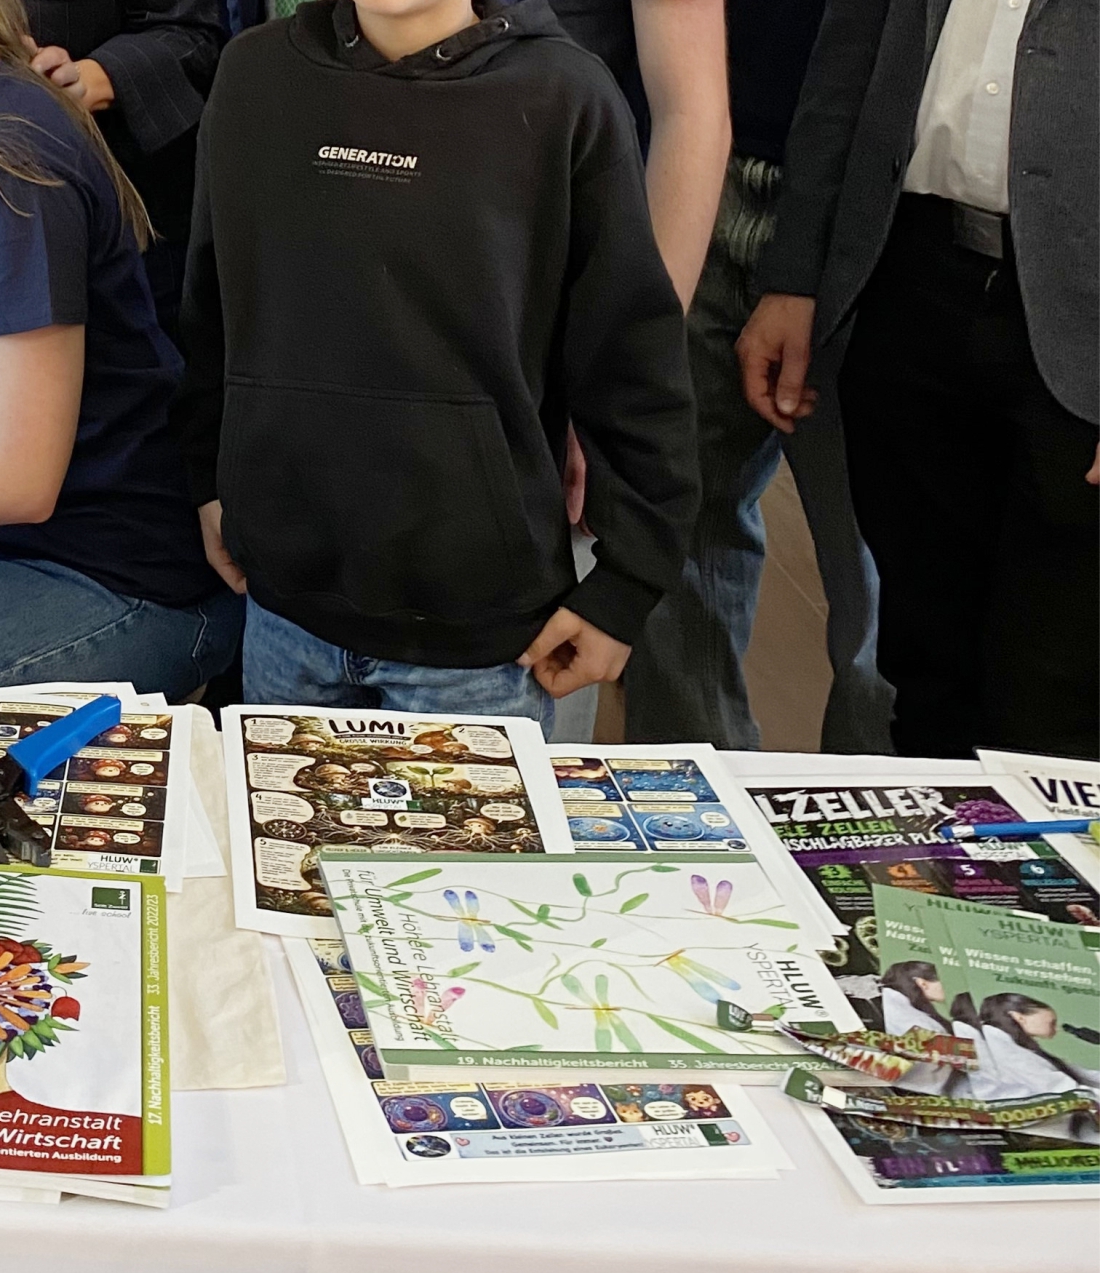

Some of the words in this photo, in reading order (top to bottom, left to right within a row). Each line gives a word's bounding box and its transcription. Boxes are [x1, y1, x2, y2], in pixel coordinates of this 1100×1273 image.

[318, 146, 418, 169] GENERATION
[328, 719, 405, 735] LUMI
[255, 793, 262, 801] 4
[357, 869, 376, 888] für
[829, 865, 839, 876] 3
[960, 864, 976, 876] 5
[1029, 864, 1045, 875] 6
[146, 894, 159, 926] 2022/23
[365, 888, 395, 934] Umwelt
[885, 930, 928, 944] Natur
[980, 928, 1079, 950] YSPERTAL
[147, 926, 160, 980] Jahresbericht
[383, 936, 401, 964] und
[964, 947, 1020, 964] Wissen
[1024, 957, 1097, 976] schaffen.
[399, 913, 428, 962] Höhere
[418, 964, 459, 1043] Lehranstalt
[743, 942, 798, 1011] YSPERTAL
[968, 958, 1010, 973] Natur
[1015, 967, 1098, 987] verstehen.
[994, 972, 1058, 991] Zukunft
[147, 983, 160, 995] 33.
[392, 969, 432, 1043] Wirtschaft
[147, 1005, 164, 1111] Nachhaltigkeitsbericht
[457, 1056, 478, 1066] 19.
[483, 1056, 649, 1070] Nachhaltigkeitsbericht
[667, 1059, 688, 1070] 35.
[694, 1059, 789, 1072] Jahresbericht
[147, 1112, 162, 1125] 17.
[990, 1104, 1055, 1123] SCHOOL
[52, 1151, 122, 1164] Ausbildung
